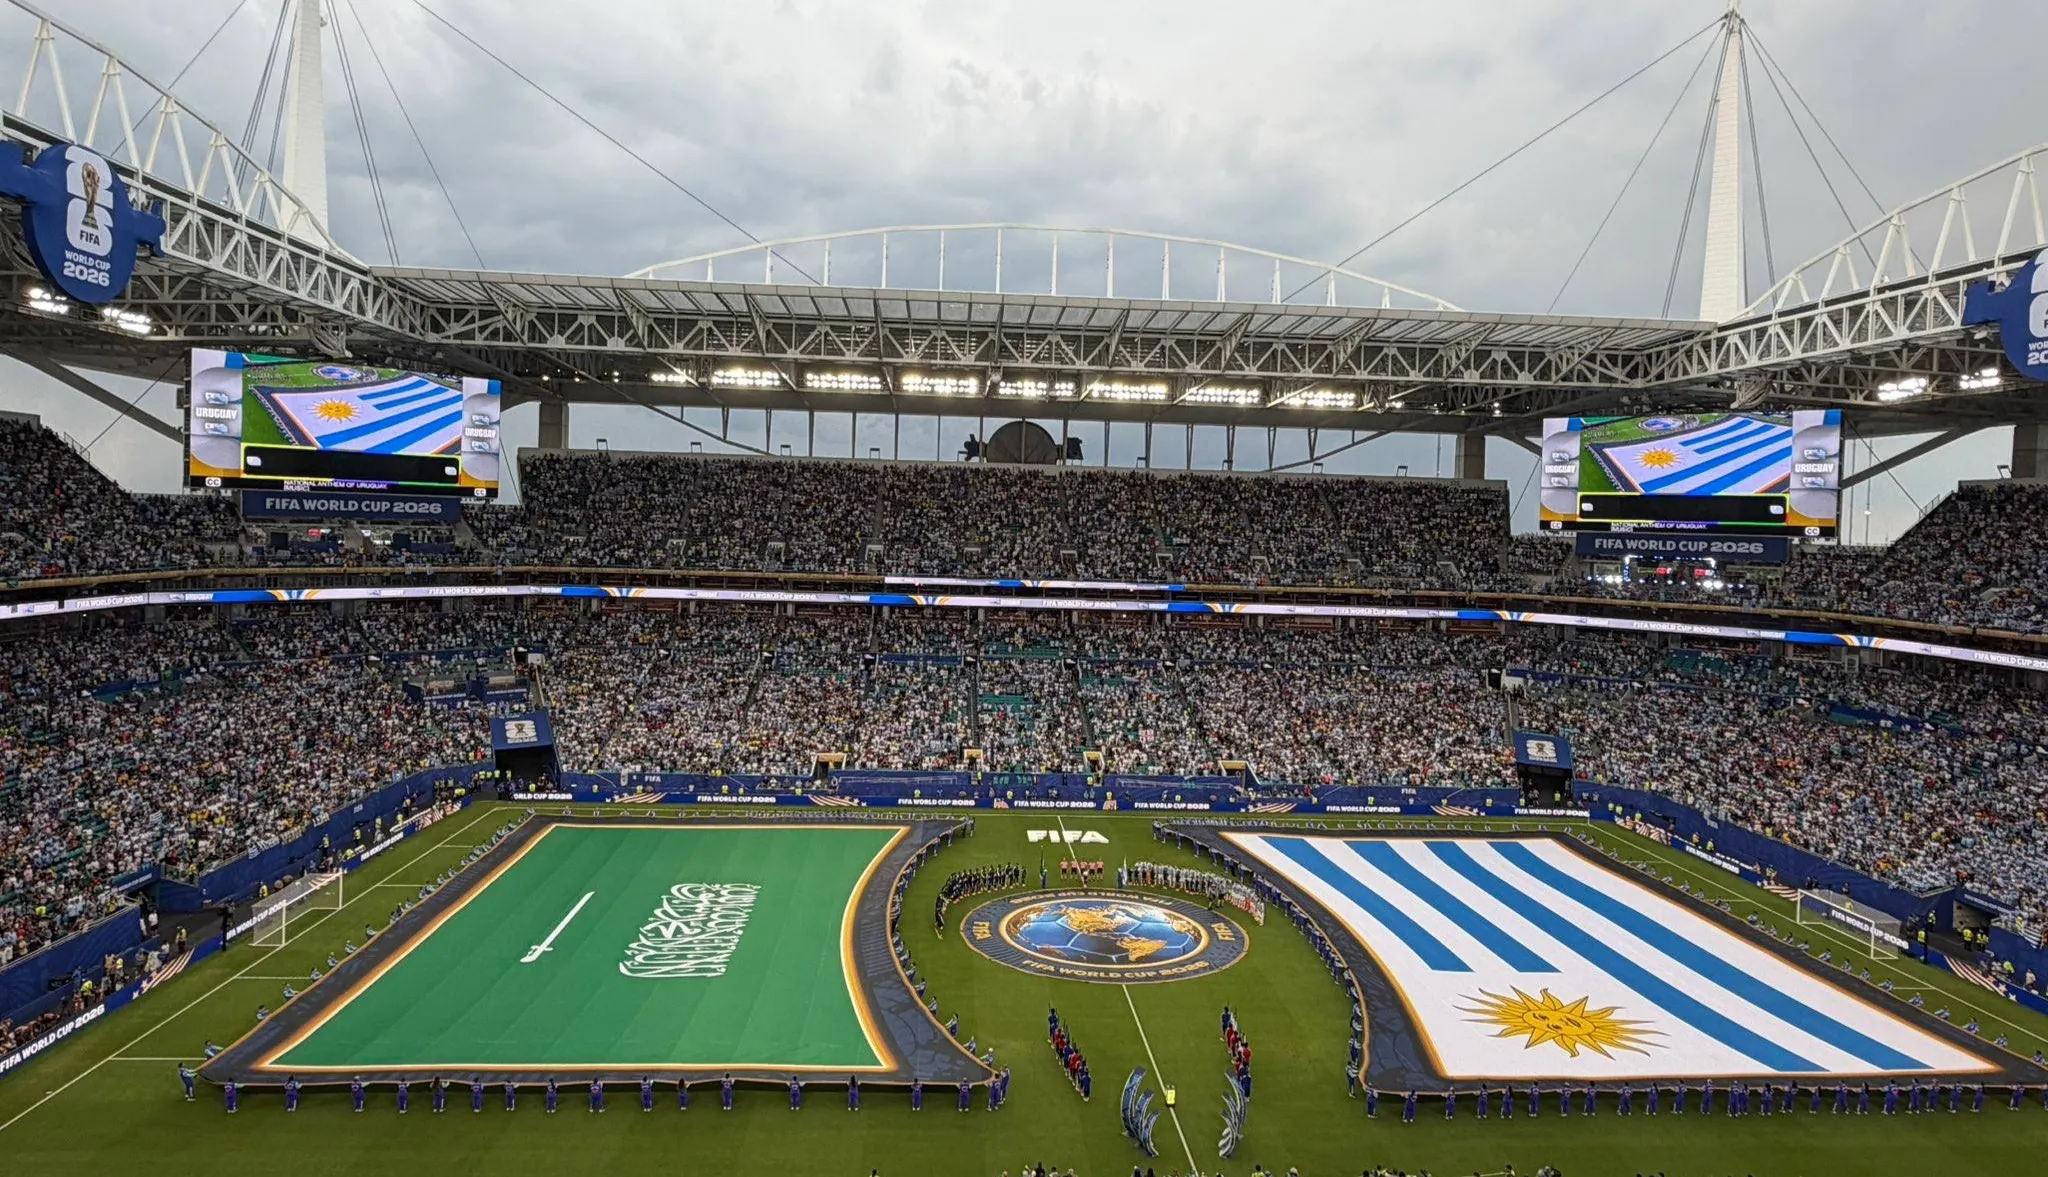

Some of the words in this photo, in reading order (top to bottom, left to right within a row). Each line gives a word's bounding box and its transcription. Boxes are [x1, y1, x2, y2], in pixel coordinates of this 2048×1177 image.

[79, 230, 100, 246] FIFA
[65, 250, 95, 266] WORLD
[95, 260, 111, 270] CUP
[63, 261, 110, 287] 2026
[2029, 341, 2048, 351] WOR
[2027, 350, 2048, 366] 20
[195, 407, 238, 420] URUGUAY
[465, 427, 497, 438] URUGUAY
[1795, 463, 1834, 473] URUGUAY
[265, 498, 300, 510] FIFA
[303, 499, 358, 511] WORLD
[361, 500, 391, 512] CUP
[392, 502, 442, 514] 2026
[1594, 538, 1624, 549] FIFA
[1625, 539, 1676, 551] WORLD
[1679, 541, 1708, 552] CUP
[1710, 542, 1763, 554] 2026
[1974, 652, 1989, 660] FIFA
[1990, 653, 2016, 664] WORLD
[2017, 657, 2032, 666] CUP
[2032, 661, 2048, 669] 20
[1027, 830, 1109, 843] FIFA
[1211, 922, 1236, 940] FIFA
[1832, 909, 1846, 922] FIFA
[1846, 916, 1869, 932] WORLD
[1884, 932, 1909, 950] 2026
[1022, 960, 1055, 972] FIFA
[1059, 967, 1121, 978] WORLD
[1158, 961, 1209, 976] 2026
[0, 1053, 22, 1073] FIFA
[22, 1032, 56, 1059] WORLD
[56, 1021, 75, 1039] CUP
[75, 1003, 105, 1029] 2026
